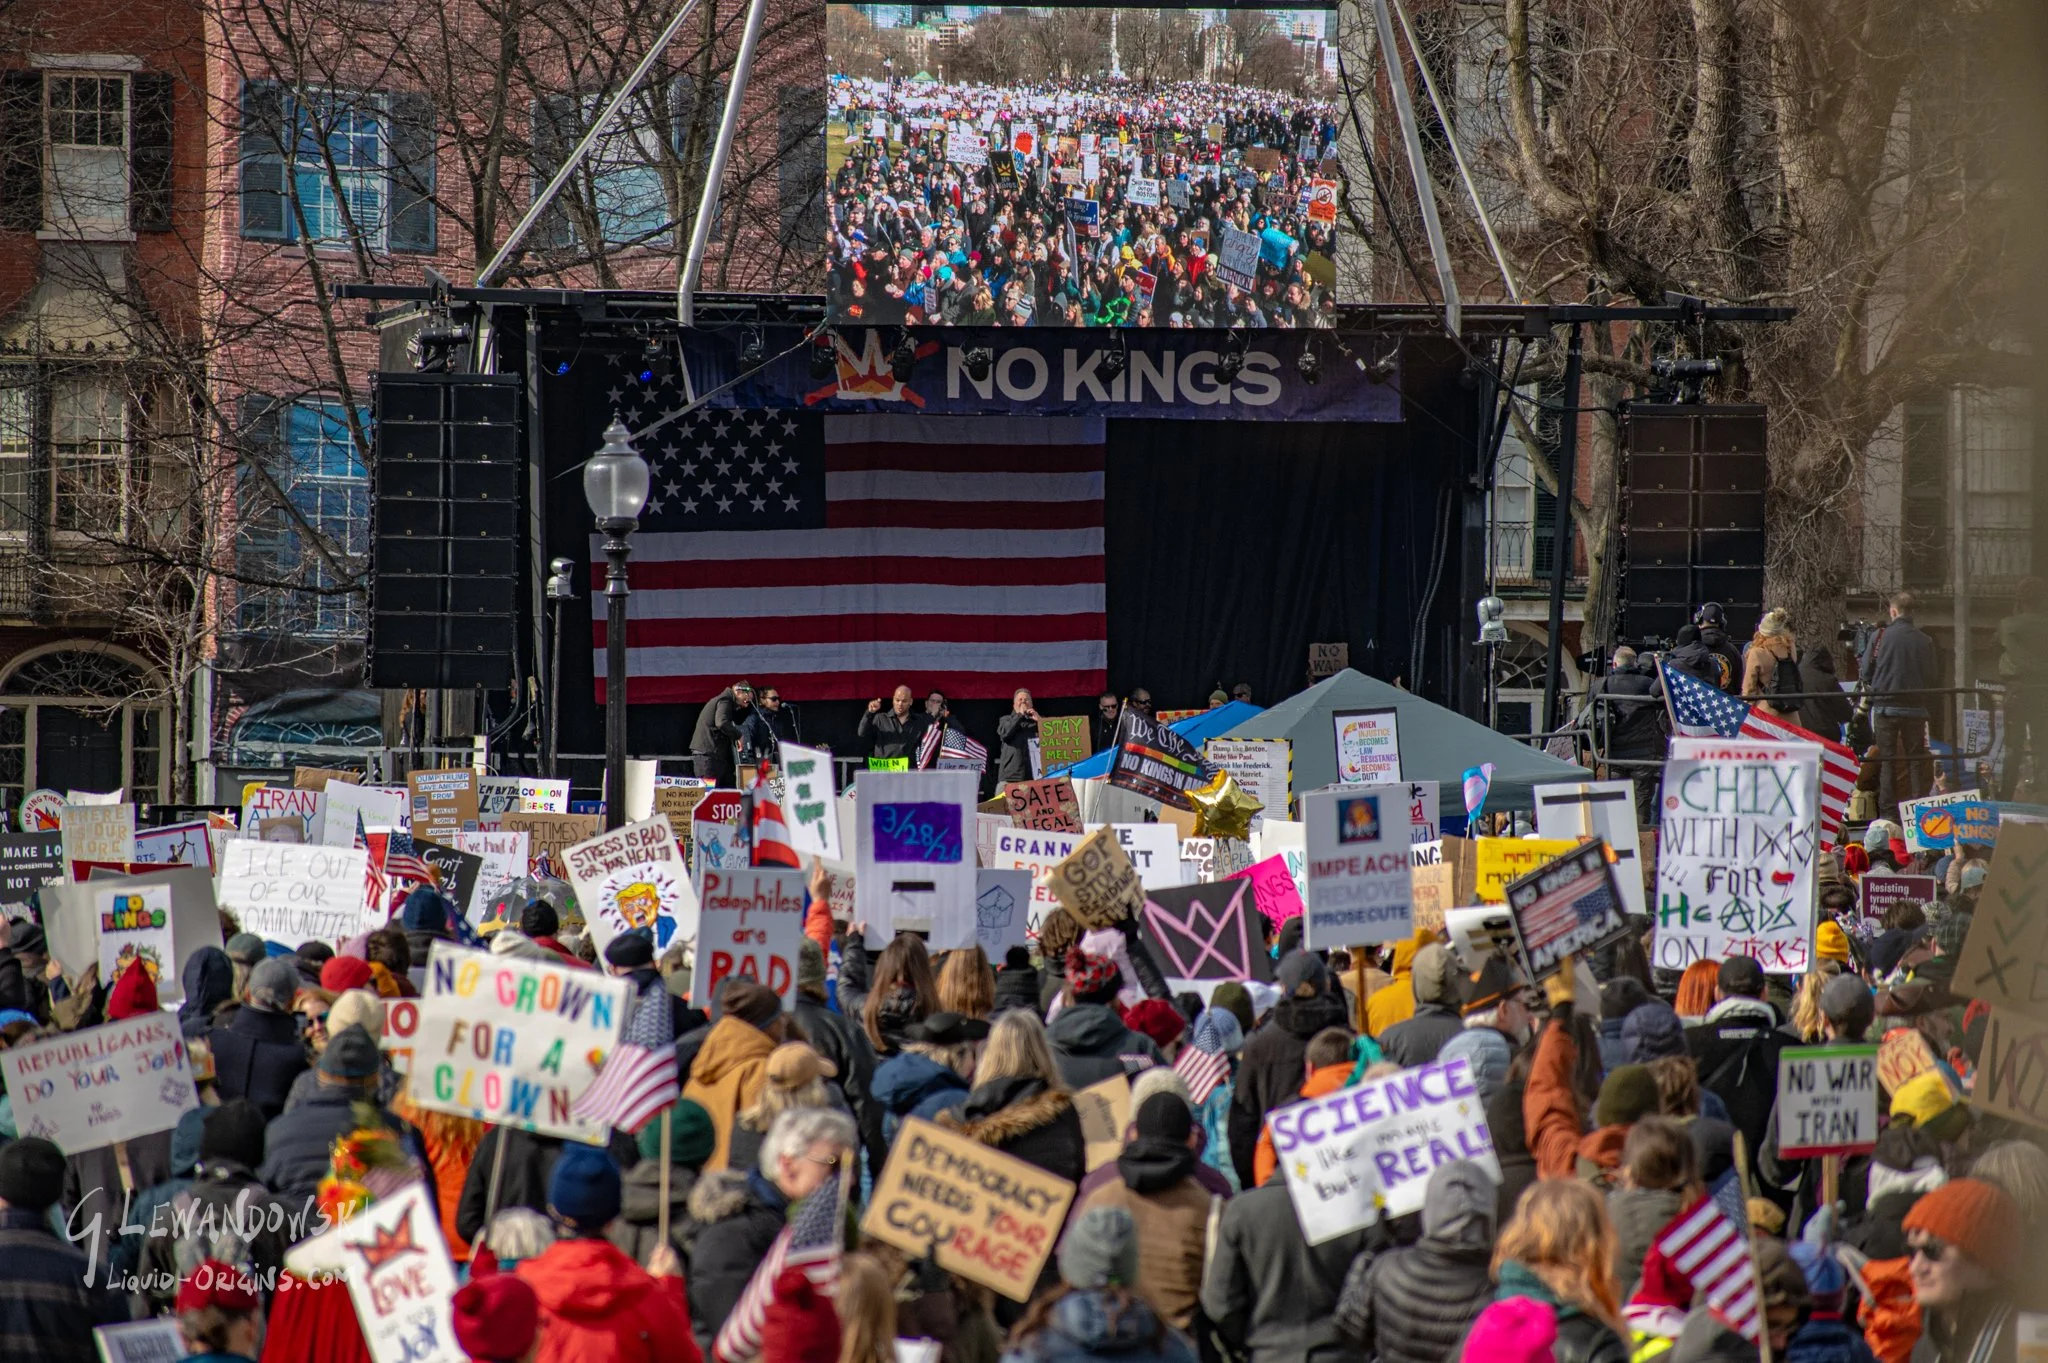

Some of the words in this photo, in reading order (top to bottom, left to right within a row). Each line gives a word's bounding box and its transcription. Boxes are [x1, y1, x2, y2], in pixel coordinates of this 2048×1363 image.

[946, 346, 1049, 401] NO
[1062, 348, 1283, 405] KINGS
[1317, 645, 1341, 658] NO
[1042, 718, 1084, 737] STAY
[1130, 713, 1155, 745] We
[1157, 724, 1185, 757] The
[1358, 721, 1377, 730] WHEN
[1358, 728, 1391, 737] INJUSTICE
[1040, 737, 1082, 748] SALTY
[1232, 744, 1244, 752] like
[1359, 737, 1389, 746] BECOMES
[1360, 747, 1373, 755] LAW
[1046, 750, 1082, 760] MELT
[1360, 754, 1398, 763] RESISTANCE
[1120, 754, 1140, 772] NO
[1140, 758, 1175, 785] KINGS
[1174, 771, 1184, 790] IN
[1361, 763, 1392, 772] BECOMES
[1361, 773, 1379, 781] DUTY
[495, 786, 505, 795] BY
[521, 788, 562, 798] COMMON
[674, 779, 699, 787] KINGS!
[1681, 765, 1800, 817] CHIX
[252, 788, 318, 813] IRAN
[1011, 783, 1070, 812] SAFE
[248, 809, 317, 833] AY
[712, 803, 743, 820] STOP
[1022, 815, 1074, 831] LEGAL
[1036, 807, 1055, 816] AND
[1966, 808, 1990, 821] NO
[94, 823, 128, 839] OUR
[510, 820, 578, 841] SOMETIMES
[1663, 817, 1739, 858] WITH
[3, 846, 38, 859] MAKE
[570, 837, 624, 869] STRESS
[625, 831, 639, 847] IS
[640, 824, 667, 847] BAD
[1185, 842, 1213, 857] NO
[240, 848, 295, 877] ICE
[308, 852, 358, 880] OUT
[422, 848, 464, 871] Can't
[578, 864, 603, 882] FOR
[601, 855, 628, 874] YOUR
[1064, 834, 1113, 886] GOP
[1310, 853, 1409, 880] IMPEACH
[7, 877, 31, 890] NOT
[250, 881, 280, 902] OF
[288, 882, 330, 906] OUR
[1075, 862, 1116, 904] STOP
[1316, 880, 1410, 905] REMOVE
[1870, 882, 1910, 896] Resisting
[114, 894, 144, 912] NO
[702, 873, 803, 925] Pedophiles
[1870, 895, 1898, 906] tyrants
[102, 909, 166, 931] KINGS
[1312, 904, 1410, 929] PROSECUTE
[732, 928, 767, 946] are
[1532, 908, 1623, 973] AMERICA
[1662, 936, 1709, 970] ON
[434, 956, 481, 999] NO
[495, 968, 614, 1030] CROWN
[446, 1018, 516, 1066] FOR
[540, 1038, 565, 1076] A
[23, 1078, 54, 1105] DO
[66, 1064, 120, 1092] YOUR
[134, 1040, 185, 1075] JOB!
[1788, 1060, 1816, 1093] NO
[1825, 1058, 1873, 1090] WAR
[434, 1064, 570, 1127] CLOWN
[1274, 1058, 1476, 1152] SCIENCE
[1796, 1108, 1859, 1145] IRAN
[908, 1134, 1062, 1217] DEMOCRACY
[901, 1170, 975, 1215] NEEDS
